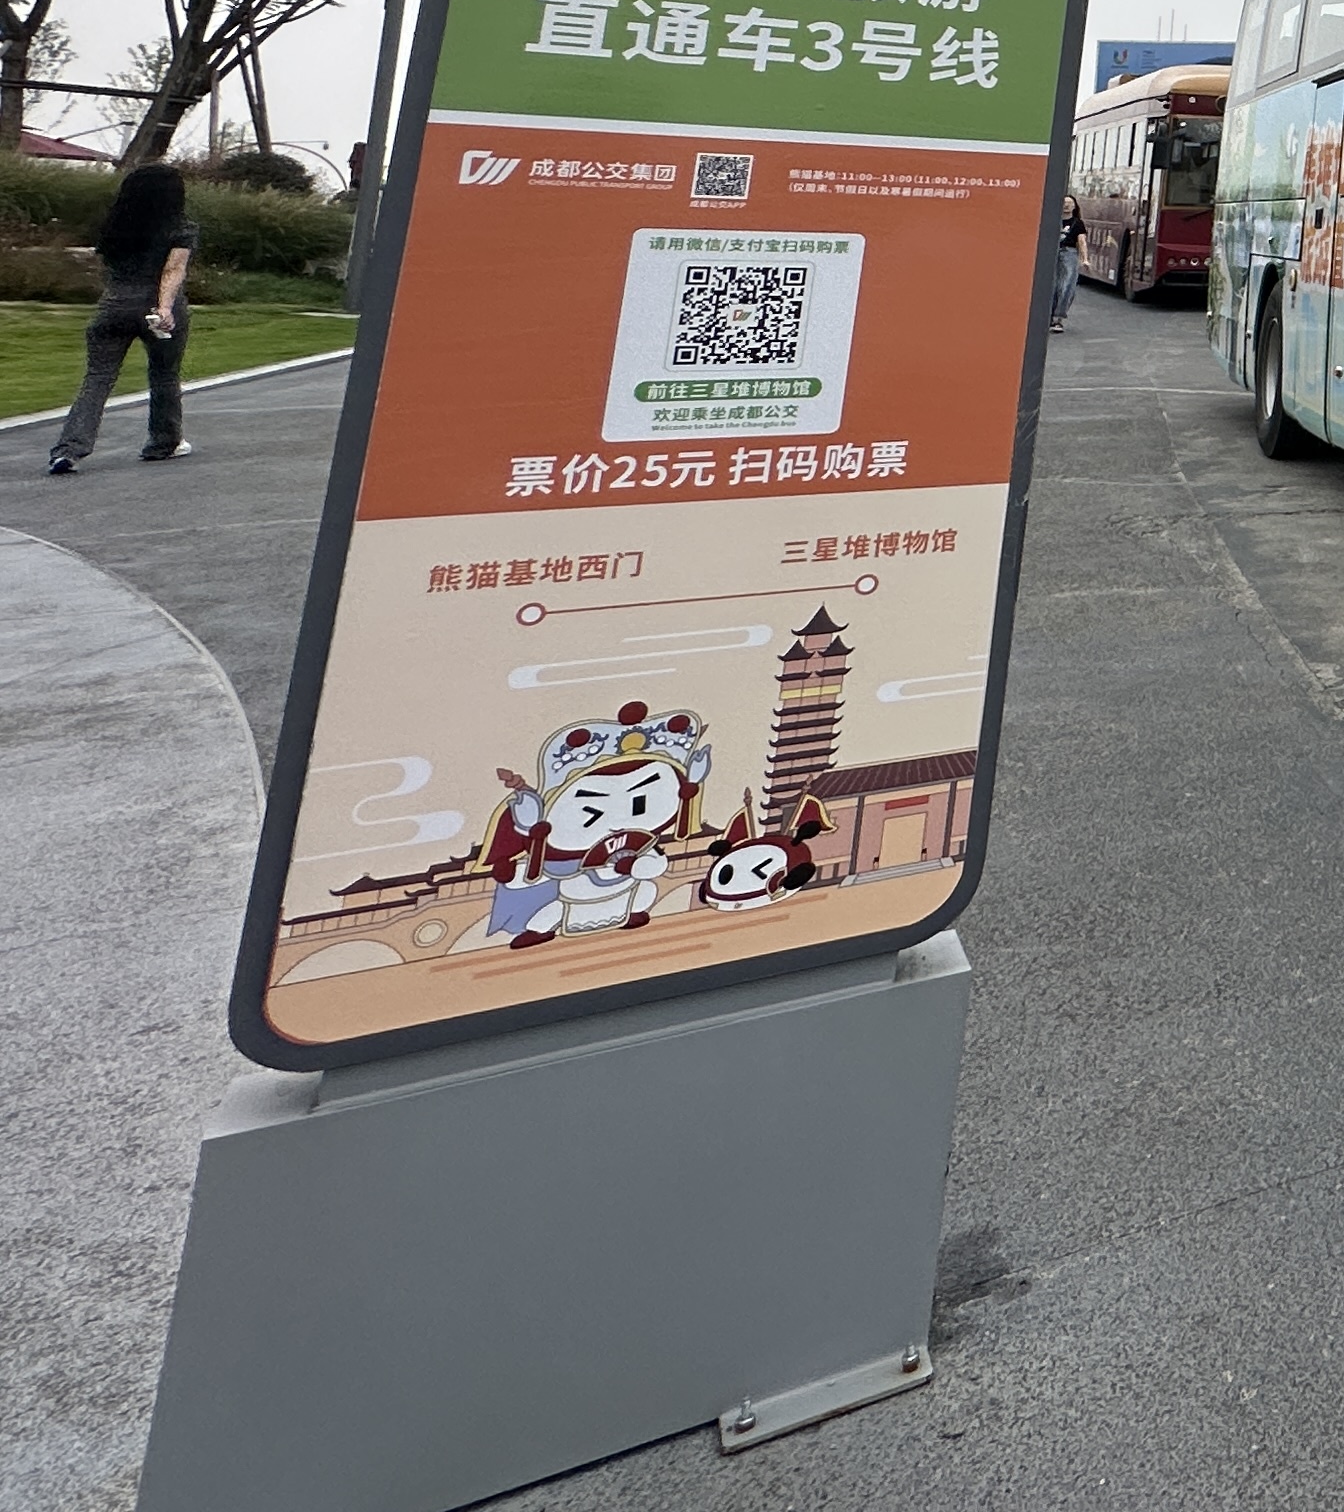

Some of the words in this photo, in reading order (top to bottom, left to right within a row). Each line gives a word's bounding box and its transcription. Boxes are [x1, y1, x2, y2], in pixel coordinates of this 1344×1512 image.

[529, 158, 677, 182] 成都公交集团
[649, 236, 850, 254] 请用微信/支付宝扫码购票
[647, 381, 811, 400] 前往三星堆博物馆
[652, 404, 799, 422] 欢迎乘坐成都公交
[505, 450, 717, 497] 票价25元
[729, 439, 909, 486] 扫码购票
[781, 528, 959, 566] 三星堆博物馆
[428, 550, 644, 594] 熊猫基地西门
